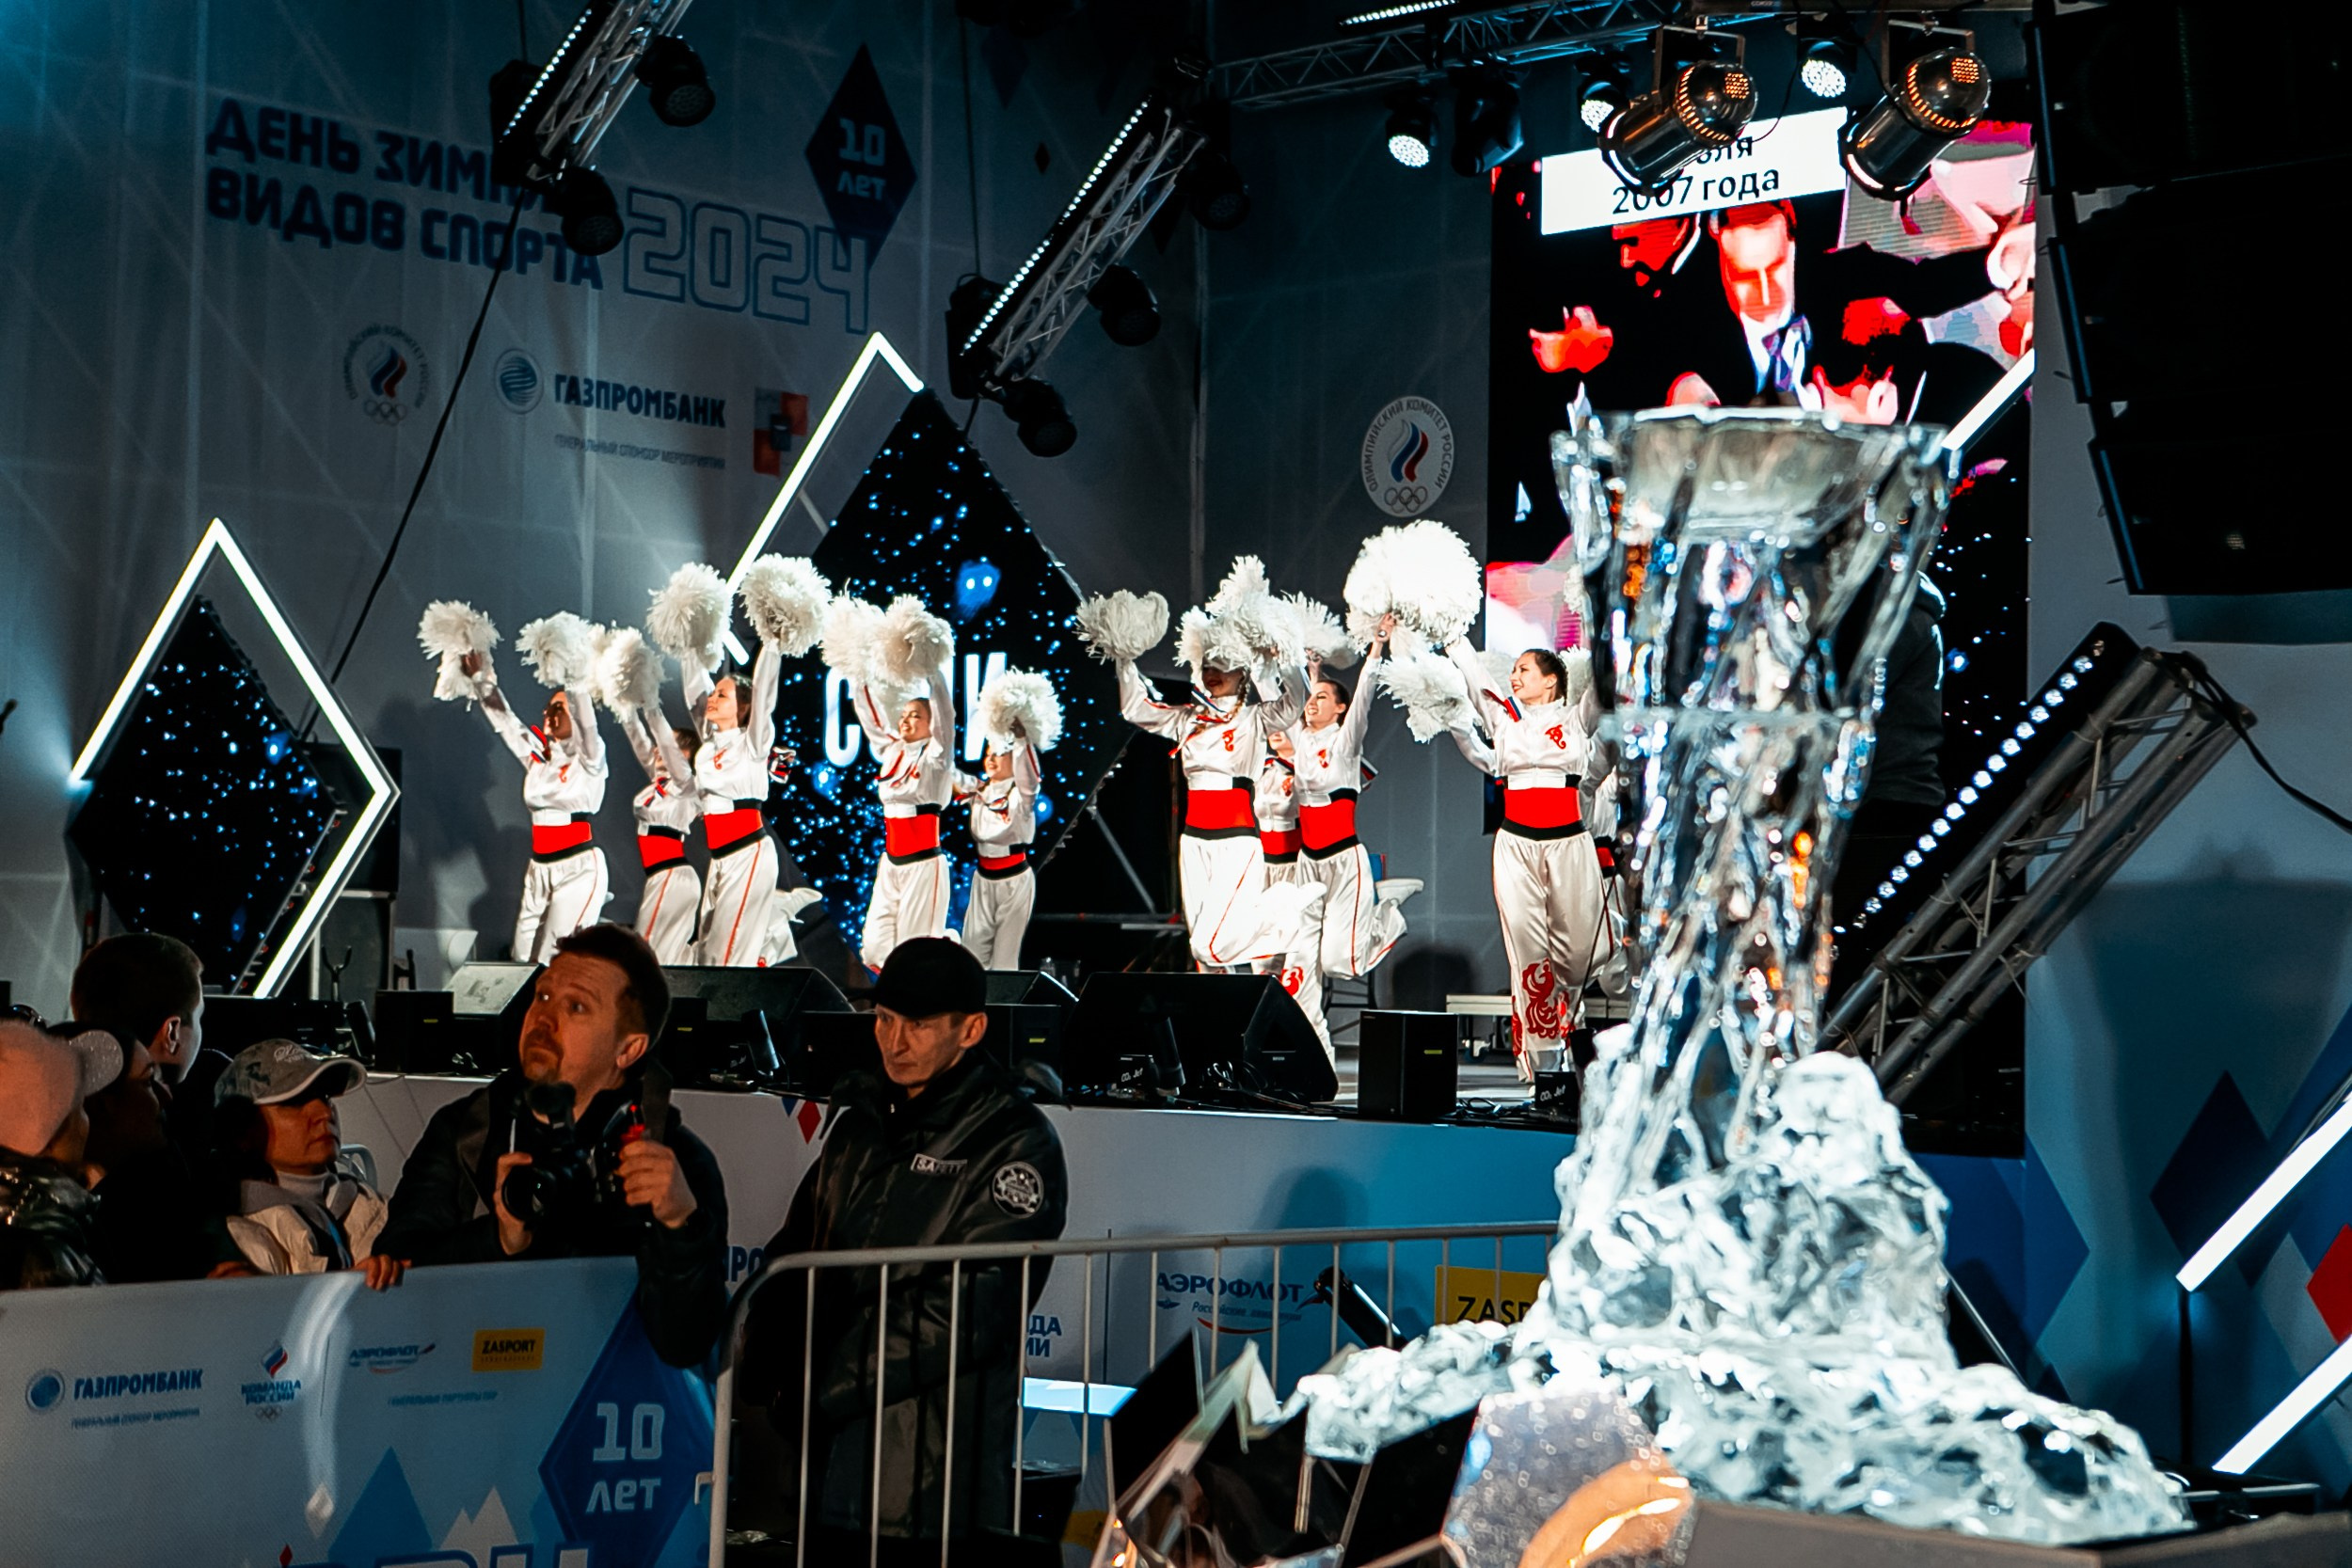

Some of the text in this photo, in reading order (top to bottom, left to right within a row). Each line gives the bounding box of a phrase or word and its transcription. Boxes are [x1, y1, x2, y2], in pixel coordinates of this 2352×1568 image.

[206, 98, 564, 214] ДЕНЬ ЗИМ
[838, 118, 886, 166] 10
[1612, 168, 1780, 214] 2007 года
[206, 167, 603, 290] ВИДОВ СПОРТА
[623, 186, 869, 336] 2024
[555, 373, 726, 429] ГАЗПРОМБАНК
[1363, 399, 1453, 493] ОЛИМПИЙСКИЙ КОМИТЕТ РОССИИ
[1157, 1272, 1304, 1303] АЭРОФЛОТ
[1192, 1301, 1247, 1318] Россйские
[1457, 1295, 1533, 1324] ZASP
[349, 1344, 421, 1359] АЭРОФЛОТ
[481, 1338, 536, 1354] ZASPORT
[73, 1369, 203, 1400] ГАЗПРОМБАНК
[241, 1380, 302, 1395] КОМАНДА
[592, 1402, 665, 1463] 10
